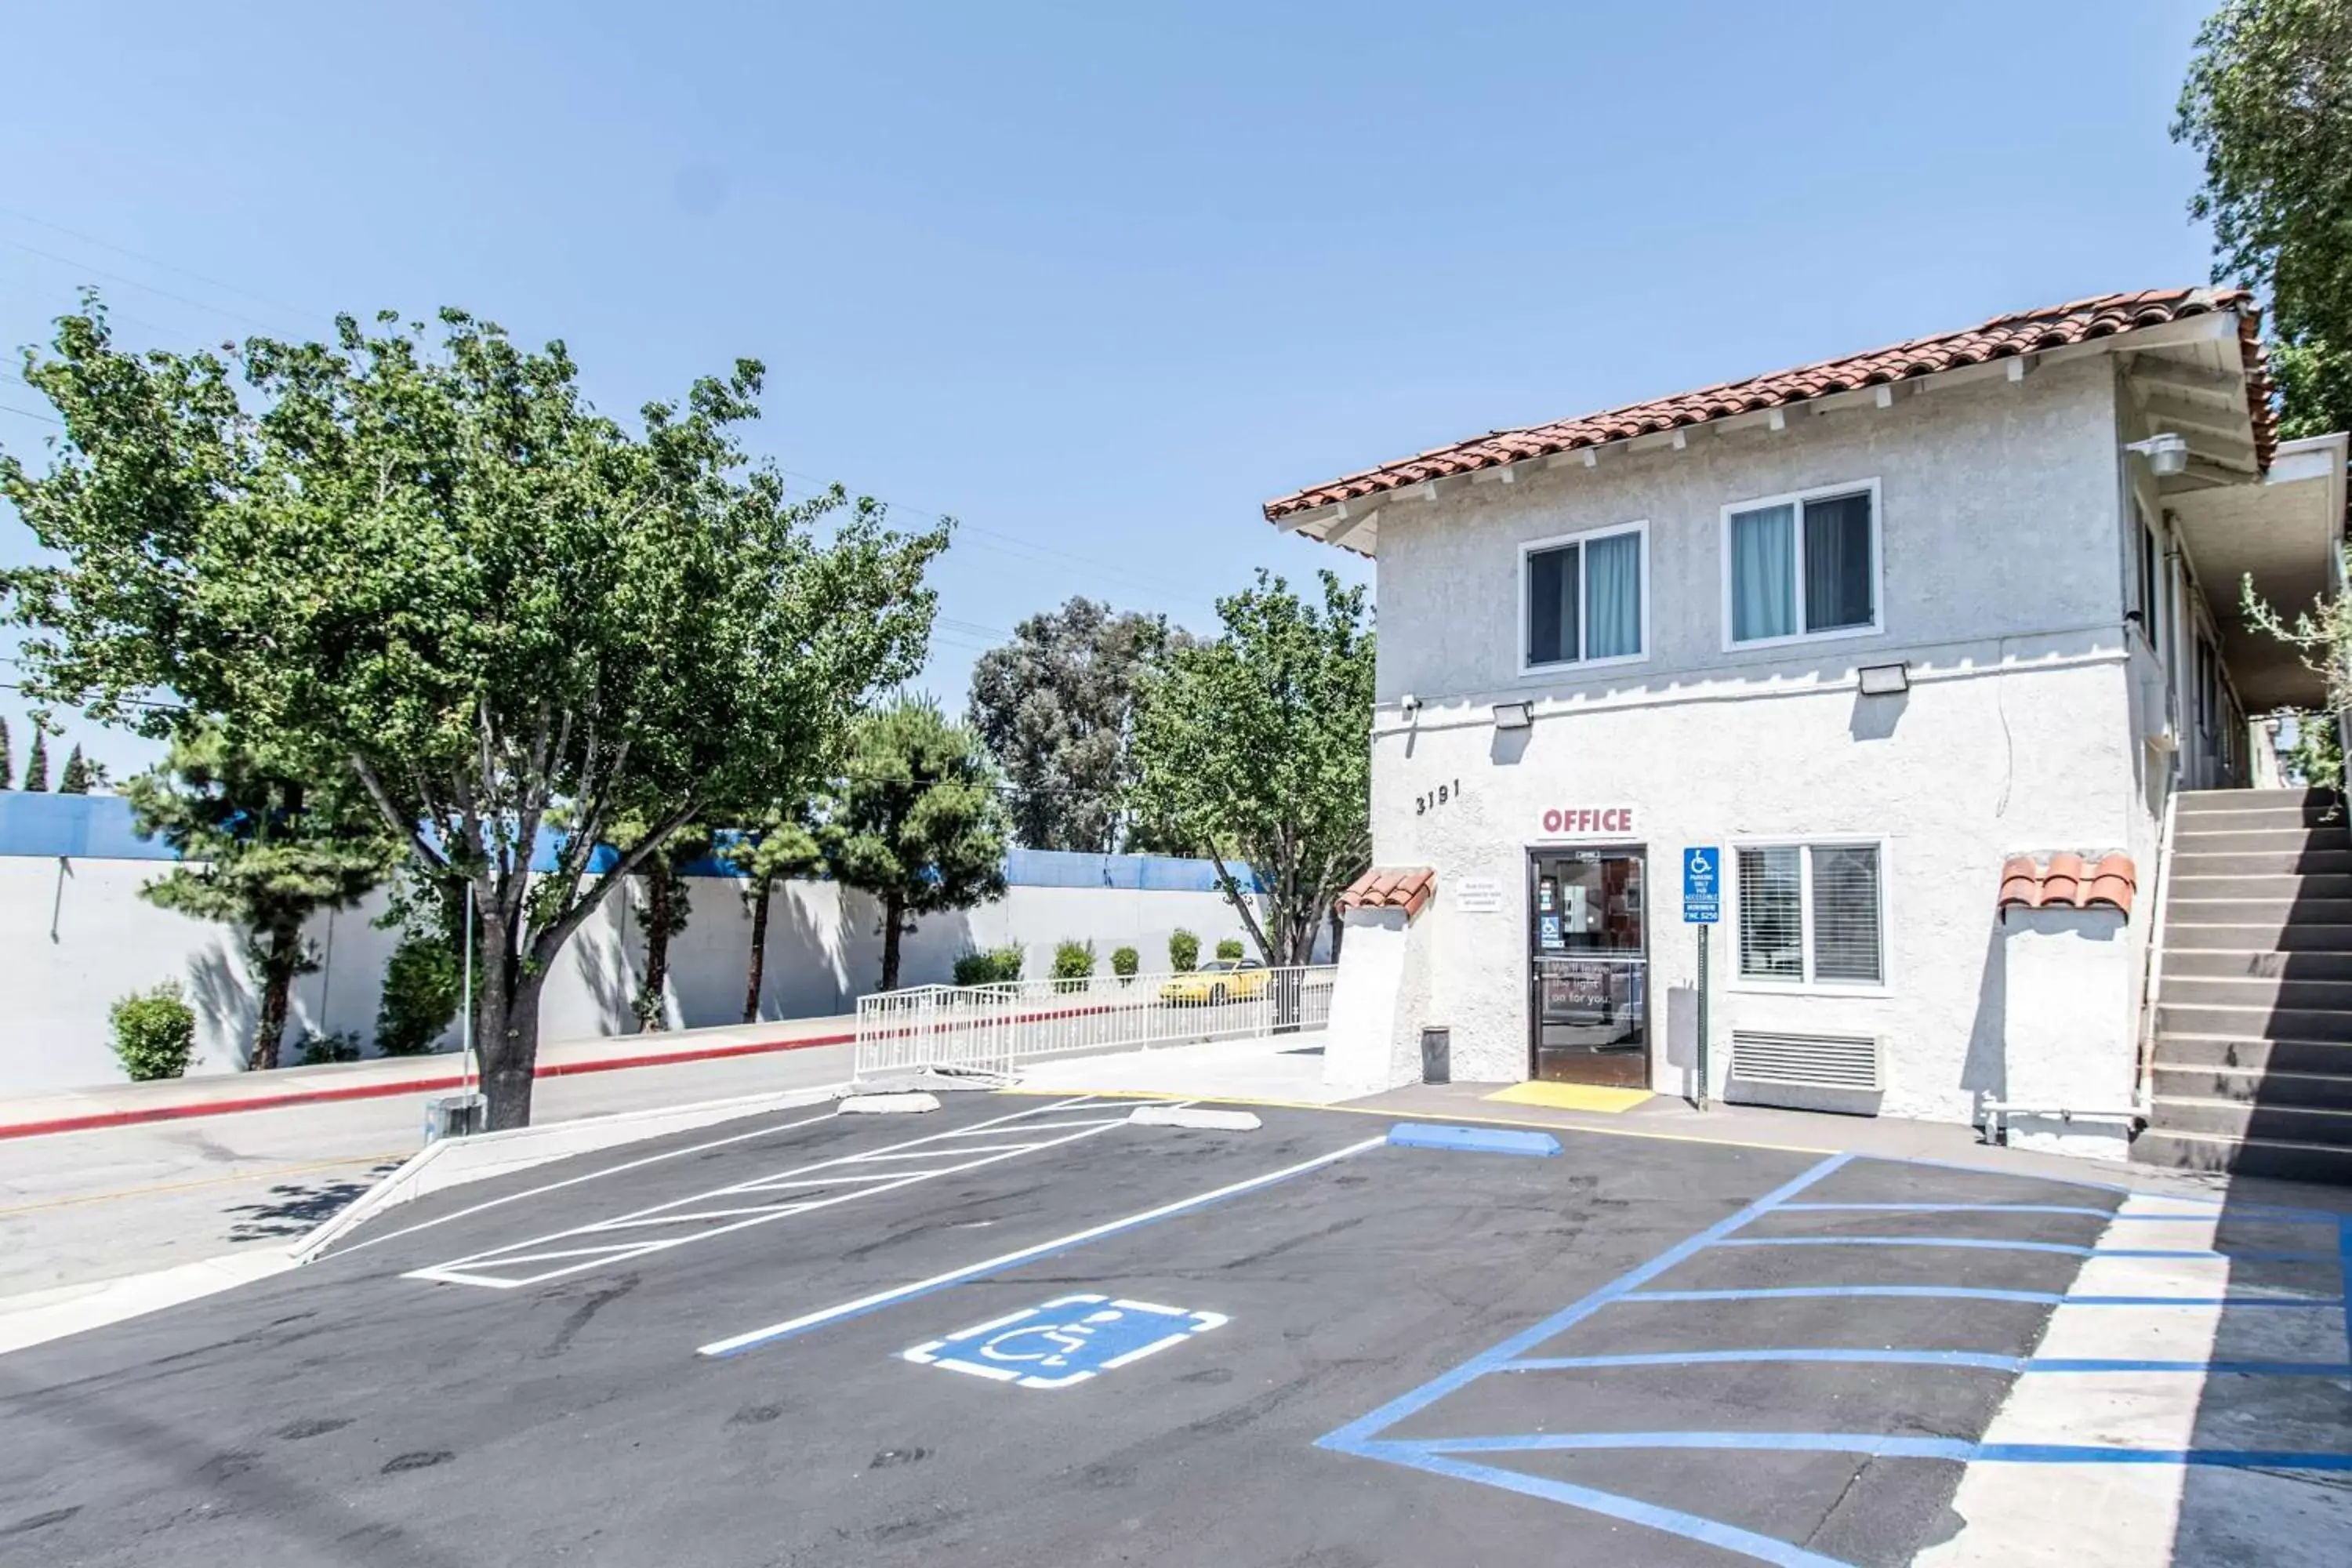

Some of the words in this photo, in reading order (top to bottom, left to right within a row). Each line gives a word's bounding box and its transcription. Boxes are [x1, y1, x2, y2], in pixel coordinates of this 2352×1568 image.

[1416, 779, 1459, 815] 3191
[1543, 808, 1632, 832] OFFICE
[1570, 992, 1584, 1003] for
[1586, 995, 1611, 1006] you.
